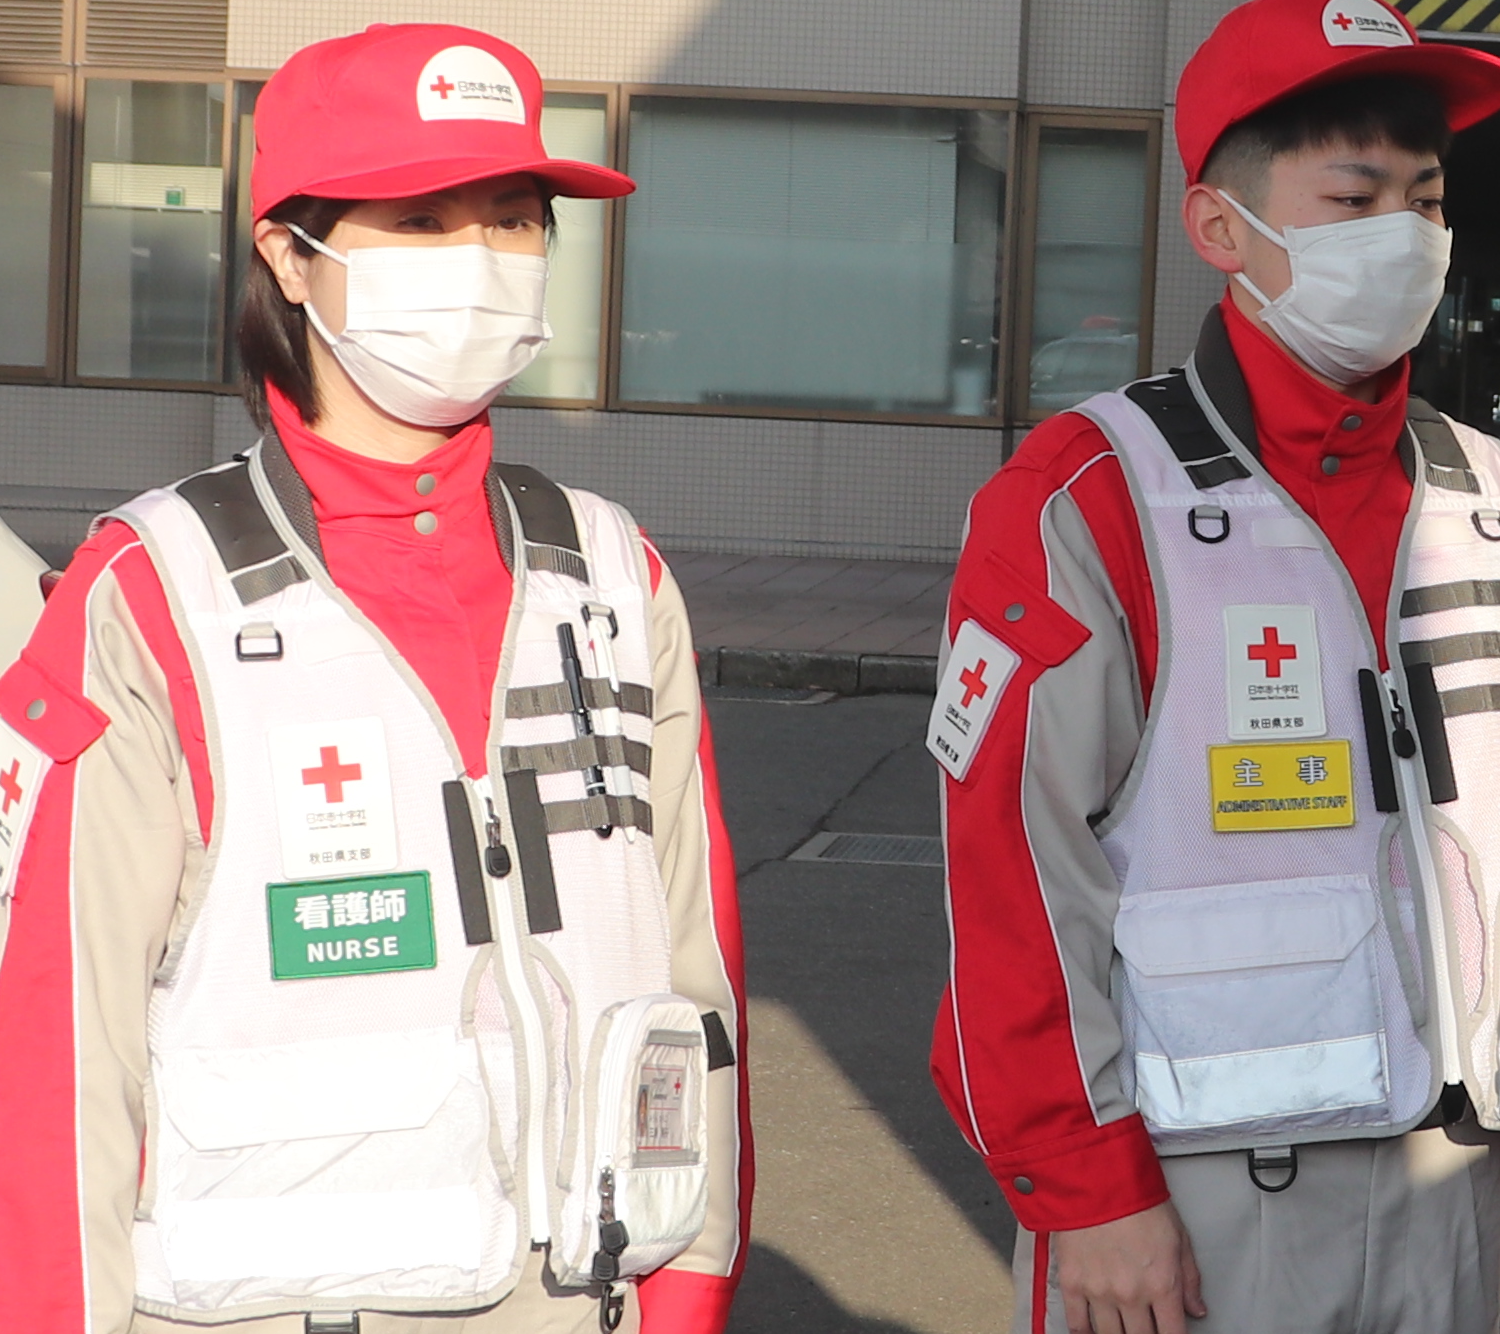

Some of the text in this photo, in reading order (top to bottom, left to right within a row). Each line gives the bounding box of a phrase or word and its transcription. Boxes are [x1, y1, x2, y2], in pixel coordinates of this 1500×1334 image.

[1233, 755, 1328, 787] 主事
[1312, 795, 1347, 809] STAFF
[294, 889, 406, 930] 看護師
[307, 936, 399, 963] NURSE
